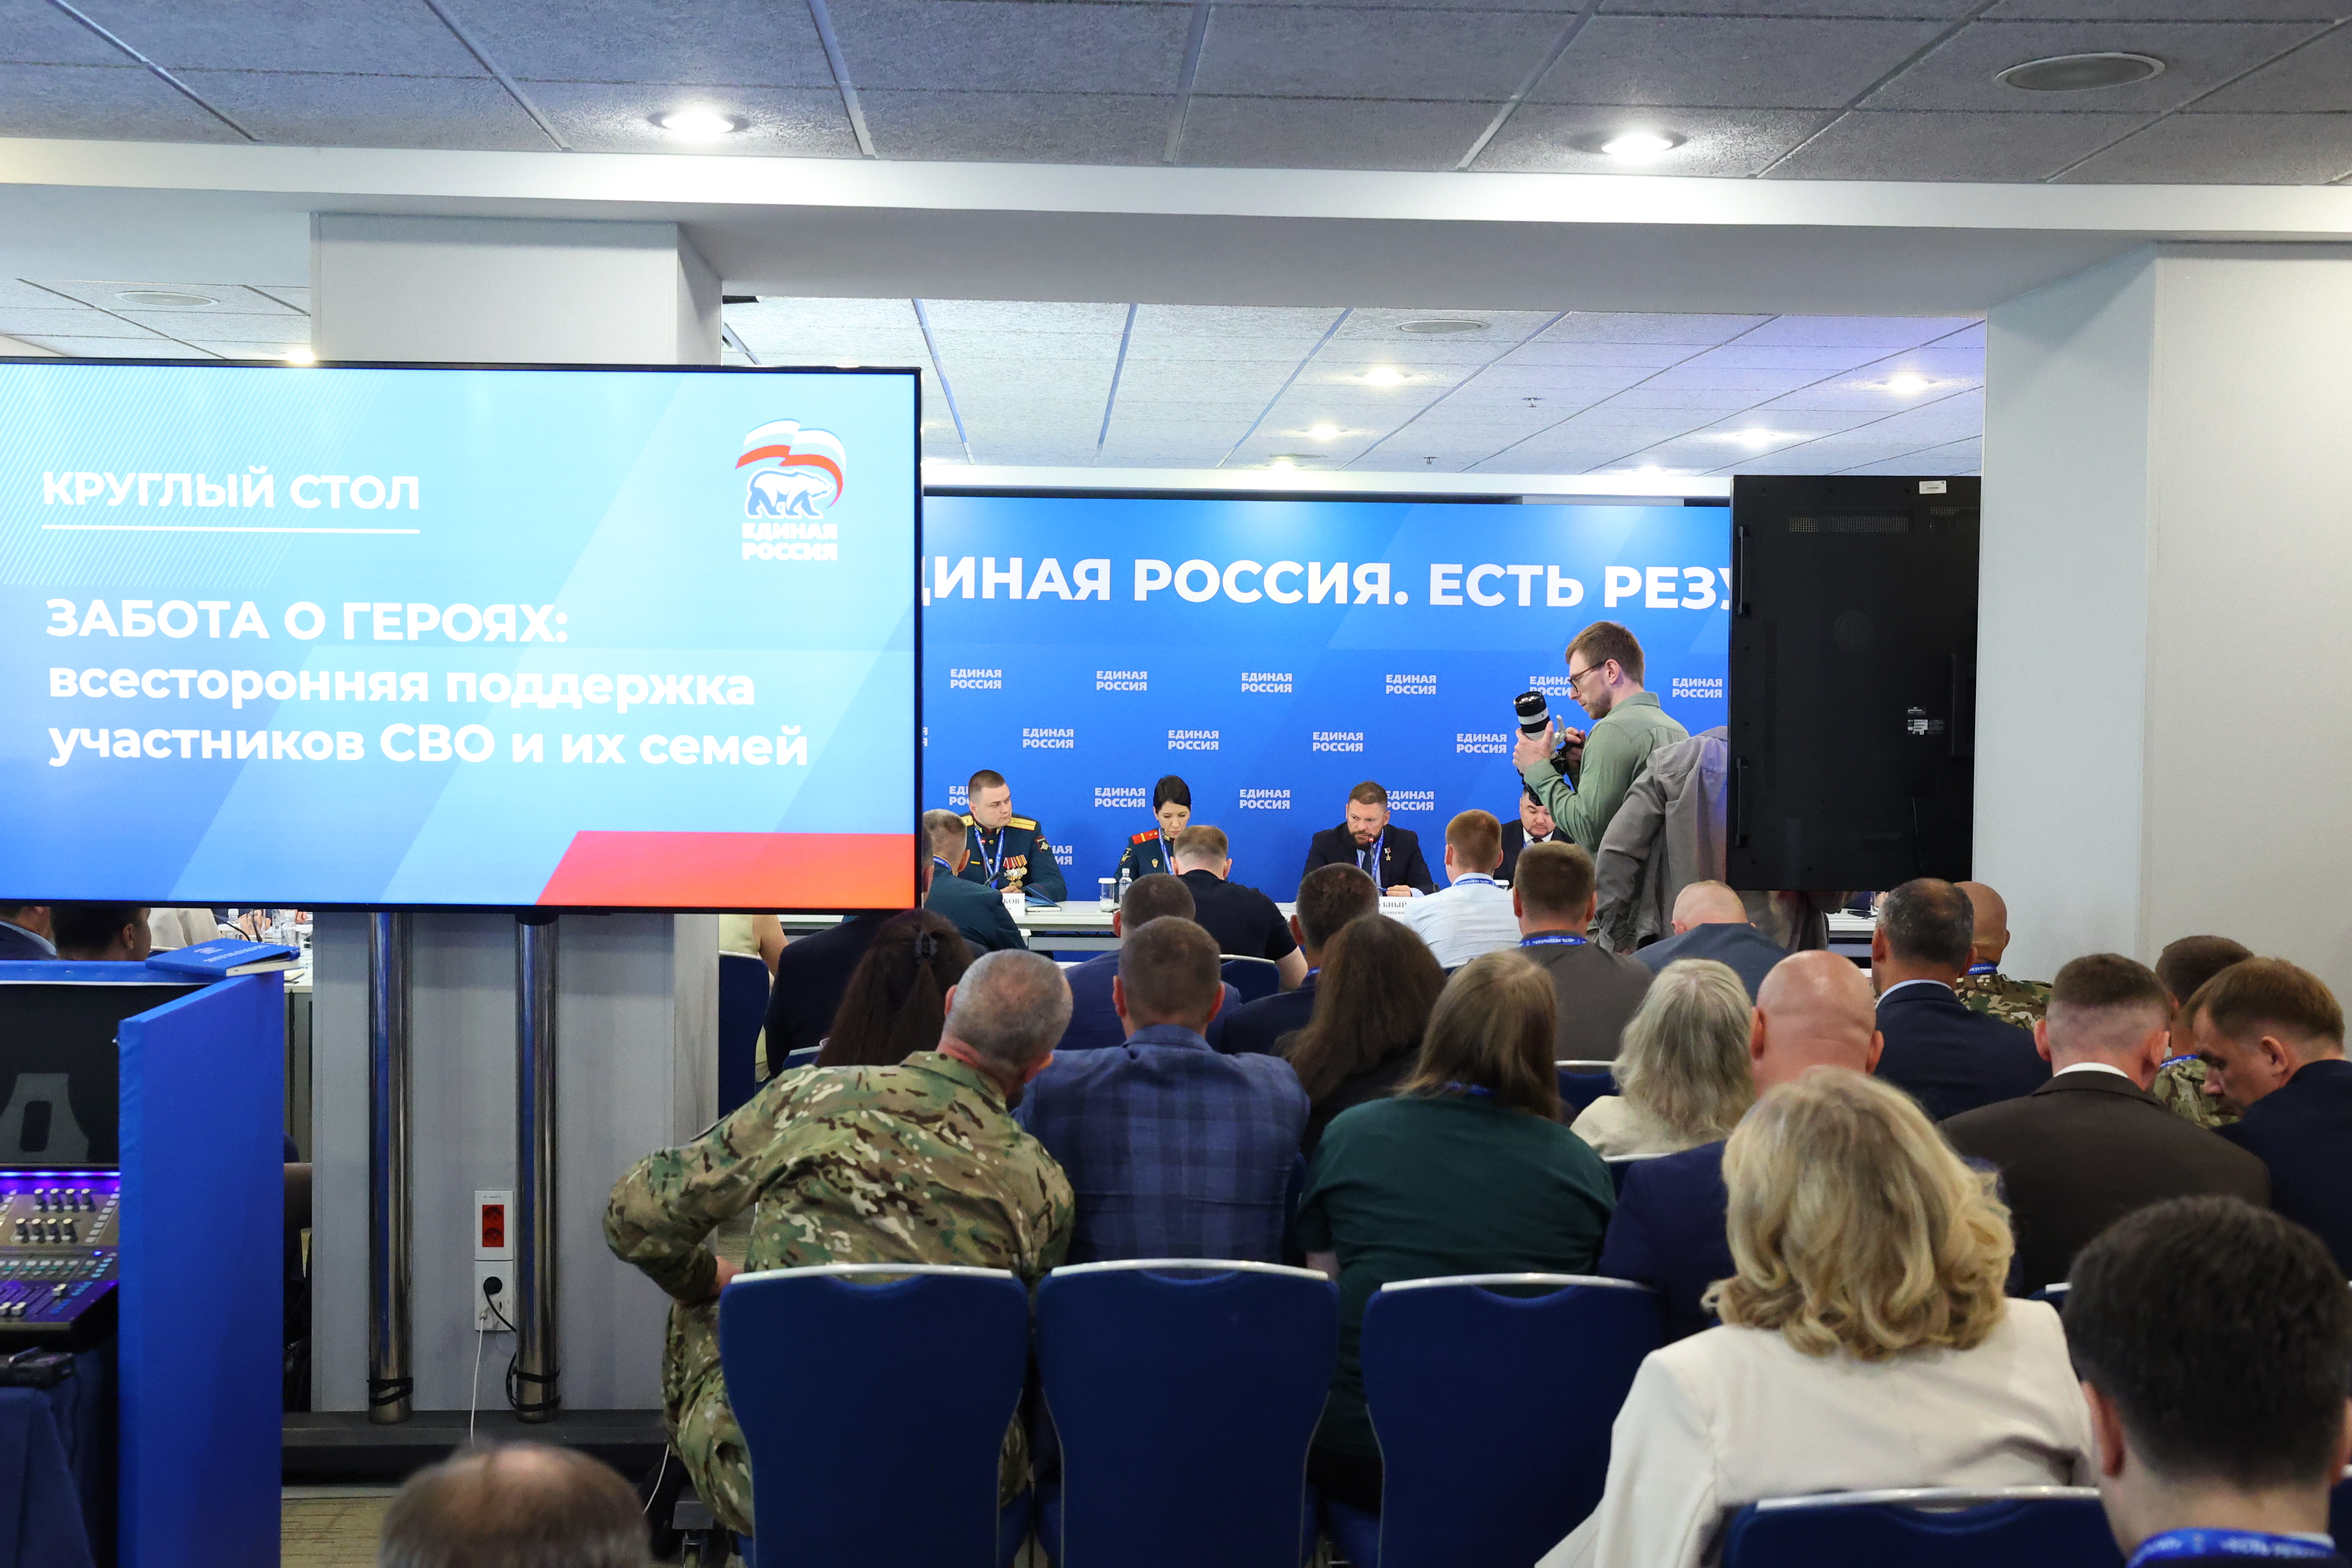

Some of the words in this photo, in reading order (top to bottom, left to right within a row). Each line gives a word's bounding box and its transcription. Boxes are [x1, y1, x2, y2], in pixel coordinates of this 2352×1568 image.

[43, 466, 273, 507] КРУГЛЫЙ
[291, 475, 419, 509] СТОЛ
[742, 523, 837, 541] ЕДИНАЯ
[742, 542, 837, 560] РОССИЯ
[923, 556, 1110, 606] ИНАЯ
[1134, 559, 1408, 605] РОССИЯ.
[1430, 564, 1584, 607] ЕСТЬ
[1605, 566, 1729, 610] РЕЗ
[46, 598, 270, 638] ЗАБОТА
[285, 602, 325, 640] О
[343, 603, 568, 642] ГЕРОЯХ:
[950, 668, 1002, 679] ЕДИНАЯ
[1096, 671, 1148, 680] ЕДИНАЯ
[1241, 672, 1292, 683] ЕДИНАЯ
[950, 679, 1002, 689] РОССИЯ
[1386, 674, 1436, 684] ЕДИНАЯ
[1529, 676, 1571, 686] ЕДИНА
[1672, 678, 1723, 688] ЕДИНАЯ
[50, 668, 428, 709] всесторонняя
[447, 672, 754, 714] поддержка
[1096, 681, 1147, 691] РОССИЯ
[1241, 683, 1292, 693] РОССИЯ
[1386, 685, 1436, 695] РОССИЯ
[1529, 686, 1571, 696] РОССИ
[1672, 688, 1722, 698] РОССИЯ
[1023, 728, 1074, 738] ЕДИНАЯ
[1168, 730, 1219, 740] ЕДИНАЯ
[1313, 732, 1363, 741] ЕДИНАЯ
[1457, 733, 1507, 743] ЕДИНАЯ
[49, 728, 364, 766] участников
[380, 723, 495, 762] СВО
[512, 733, 543, 762] и
[562, 734, 625, 763] их
[640, 725, 807, 765] семей
[1023, 738, 1074, 748] РОССИЯ
[1168, 740, 1219, 750] РОССИЯ
[1313, 742, 1363, 752] РОССИЯ
[1456, 744, 1507, 753] РОССИЯ
[1095, 787, 1145, 797] ЕДИНАЯ
[1240, 789, 1290, 799] ЕДИНАЯ
[1095, 798, 1145, 808] РОССИЯ
[1240, 799, 1290, 809] РОССИЯ
